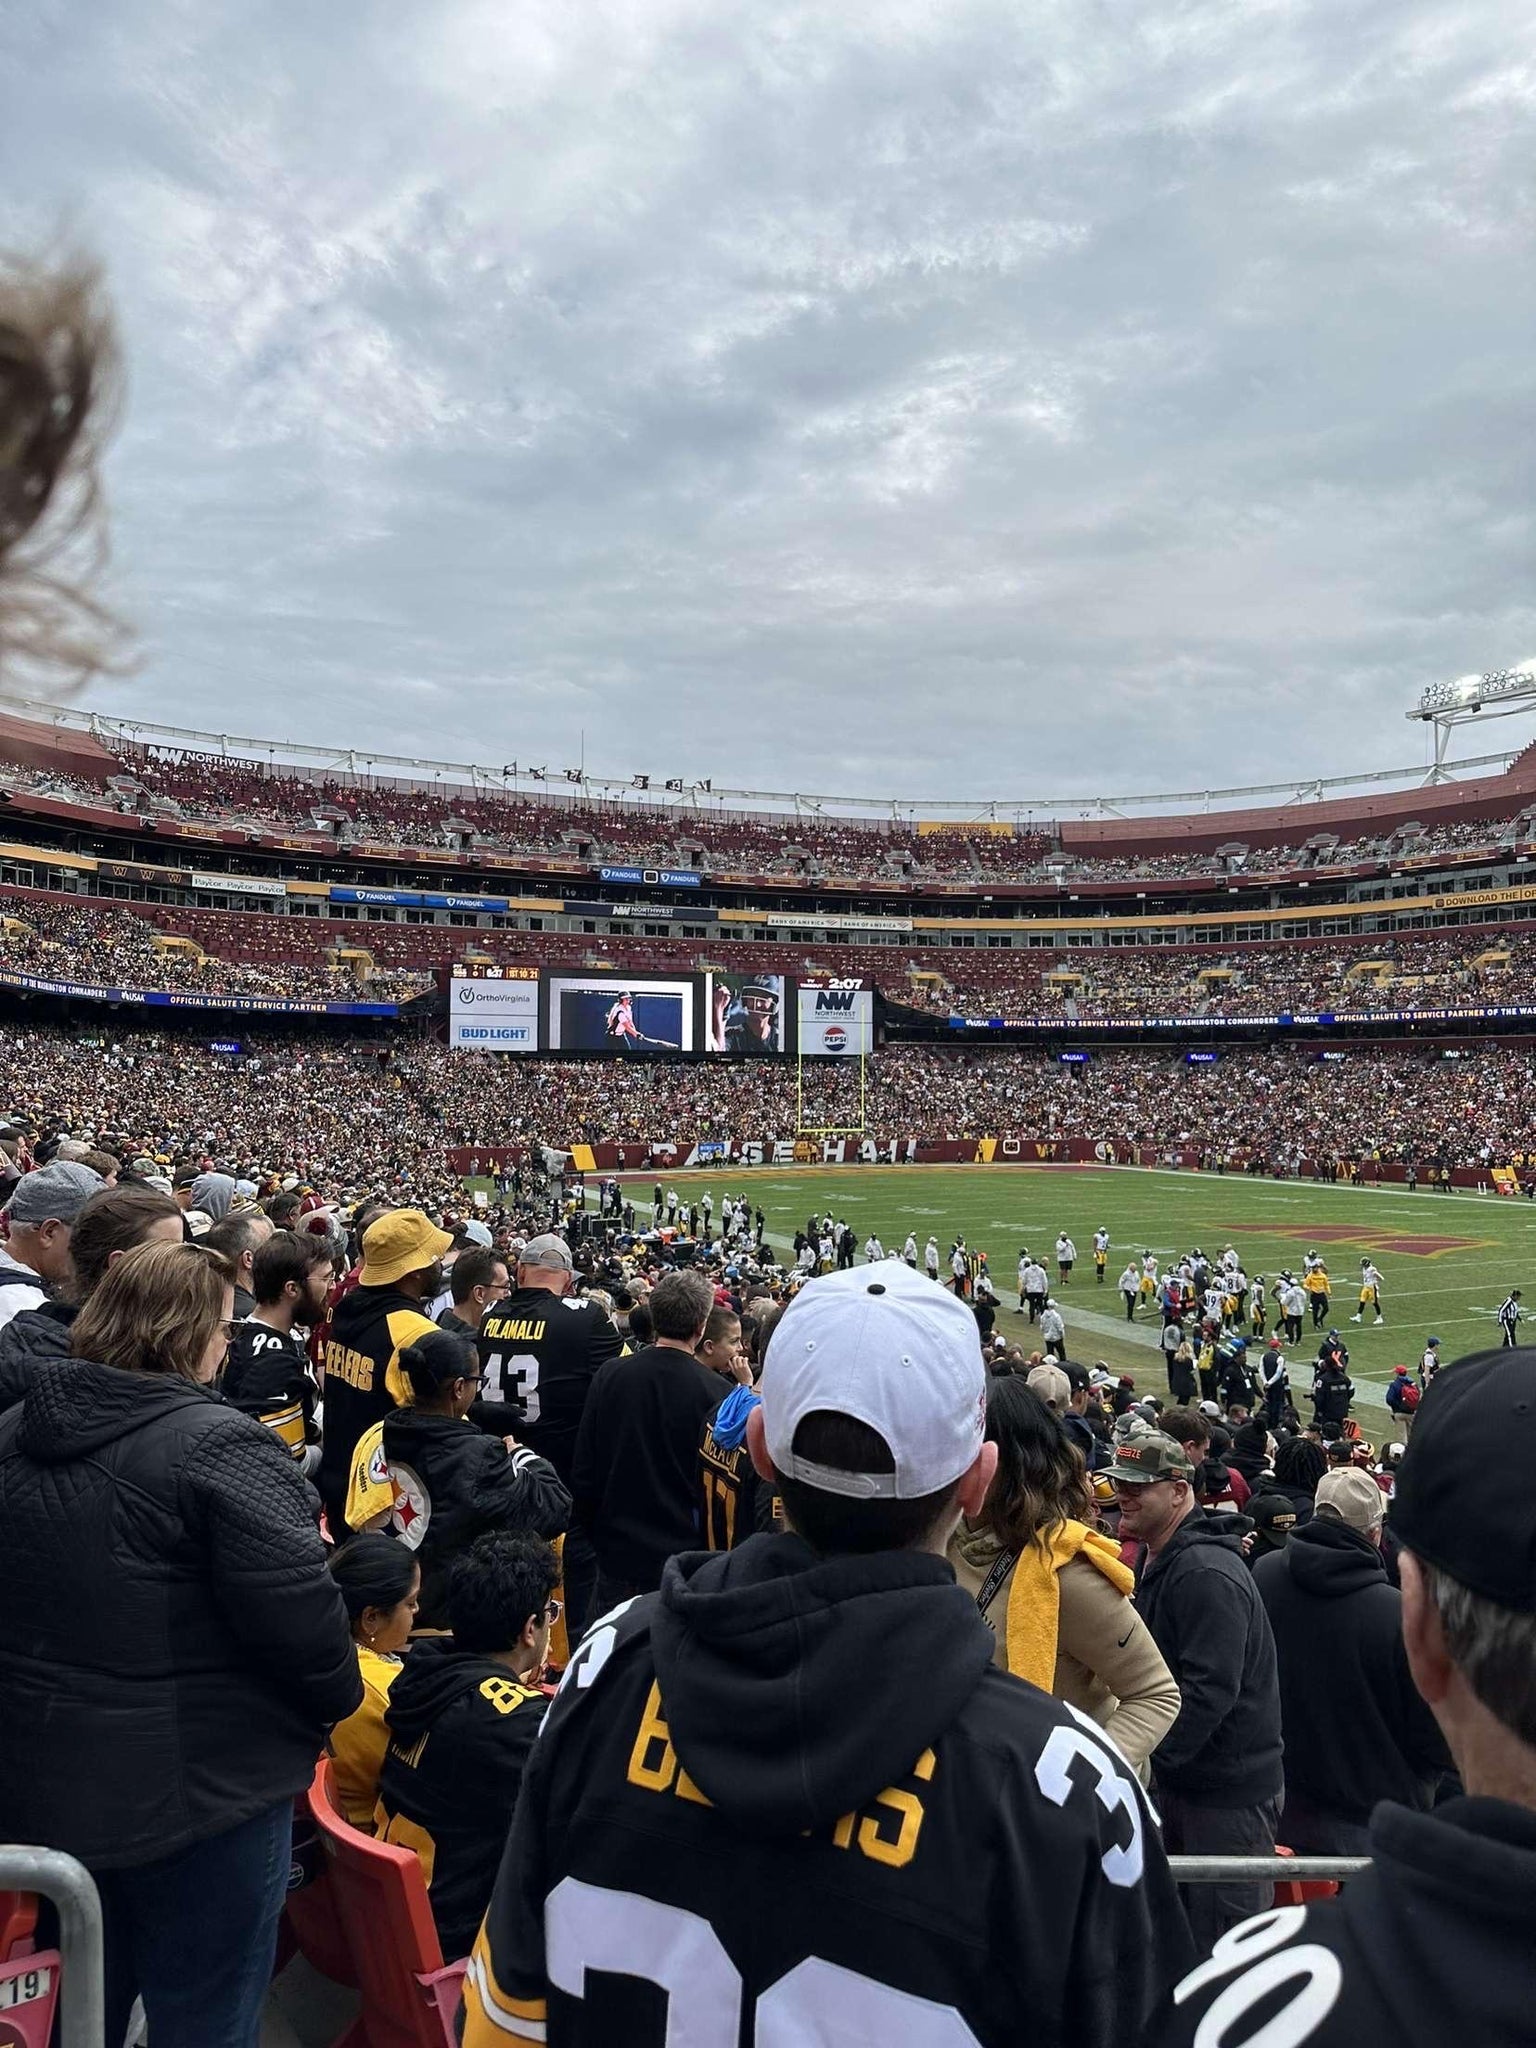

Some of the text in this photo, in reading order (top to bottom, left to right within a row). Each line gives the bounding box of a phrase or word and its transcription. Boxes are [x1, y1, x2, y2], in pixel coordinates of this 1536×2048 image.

[186, 752, 260, 771] NORTHWEST
[611, 871, 641, 879] FANDUEL
[670, 875, 699, 883] FANDUEL
[194, 878, 285, 894] Paycor Paycor Paycor
[366, 892, 397, 901] FANDUEL
[456, 899, 485, 907] FANDUEL
[1446, 893, 1498, 906] DOWNLOAD
[1500, 891, 1519, 900] THE
[631, 906, 674, 914] NORTHWEST
[22, 977, 29, 986] OF
[28, 979, 37, 988] THE
[37, 980, 67, 993] WASHINGTON
[67, 985, 107, 998] COMMANDERS
[828, 977, 863, 990] 2:07
[129, 993, 146, 1002] USAA
[170, 996, 327, 1012] OFFICIAL SALUTE TO SERVICE PARTNER
[476, 993, 531, 1003] OrthoVirginia
[815, 991, 856, 1010] NW
[1301, 1016, 1320, 1024] USAA
[1334, 1013, 1369, 1022] OFFICIAL
[1371, 1012, 1398, 1021] SALUTE
[1401, 1012, 1411, 1020] TO
[1413, 1010, 1446, 1019] SERVICE
[1447, 1009, 1485, 1018] PARTNER
[1487, 1008, 1499, 1017] OF
[1501, 1007, 1517, 1016] THE
[973, 1019, 990, 1027] USAA
[1003, 1017, 1279, 1027] OFFICIAL SALUTE TO SERVICE PARTNER OF THE WASHINGTON COMMANDERS
[461, 1028, 527, 1039] BUD LIGHT
[219, 1044, 236, 1052] USAA
[483, 1318, 546, 1340] POLAMALU
[326, 1340, 374, 1392] EELERS
[477, 1353, 540, 1422] 43
[703, 1470, 736, 1551] 17
[9, 1971, 39, 2004] 19
